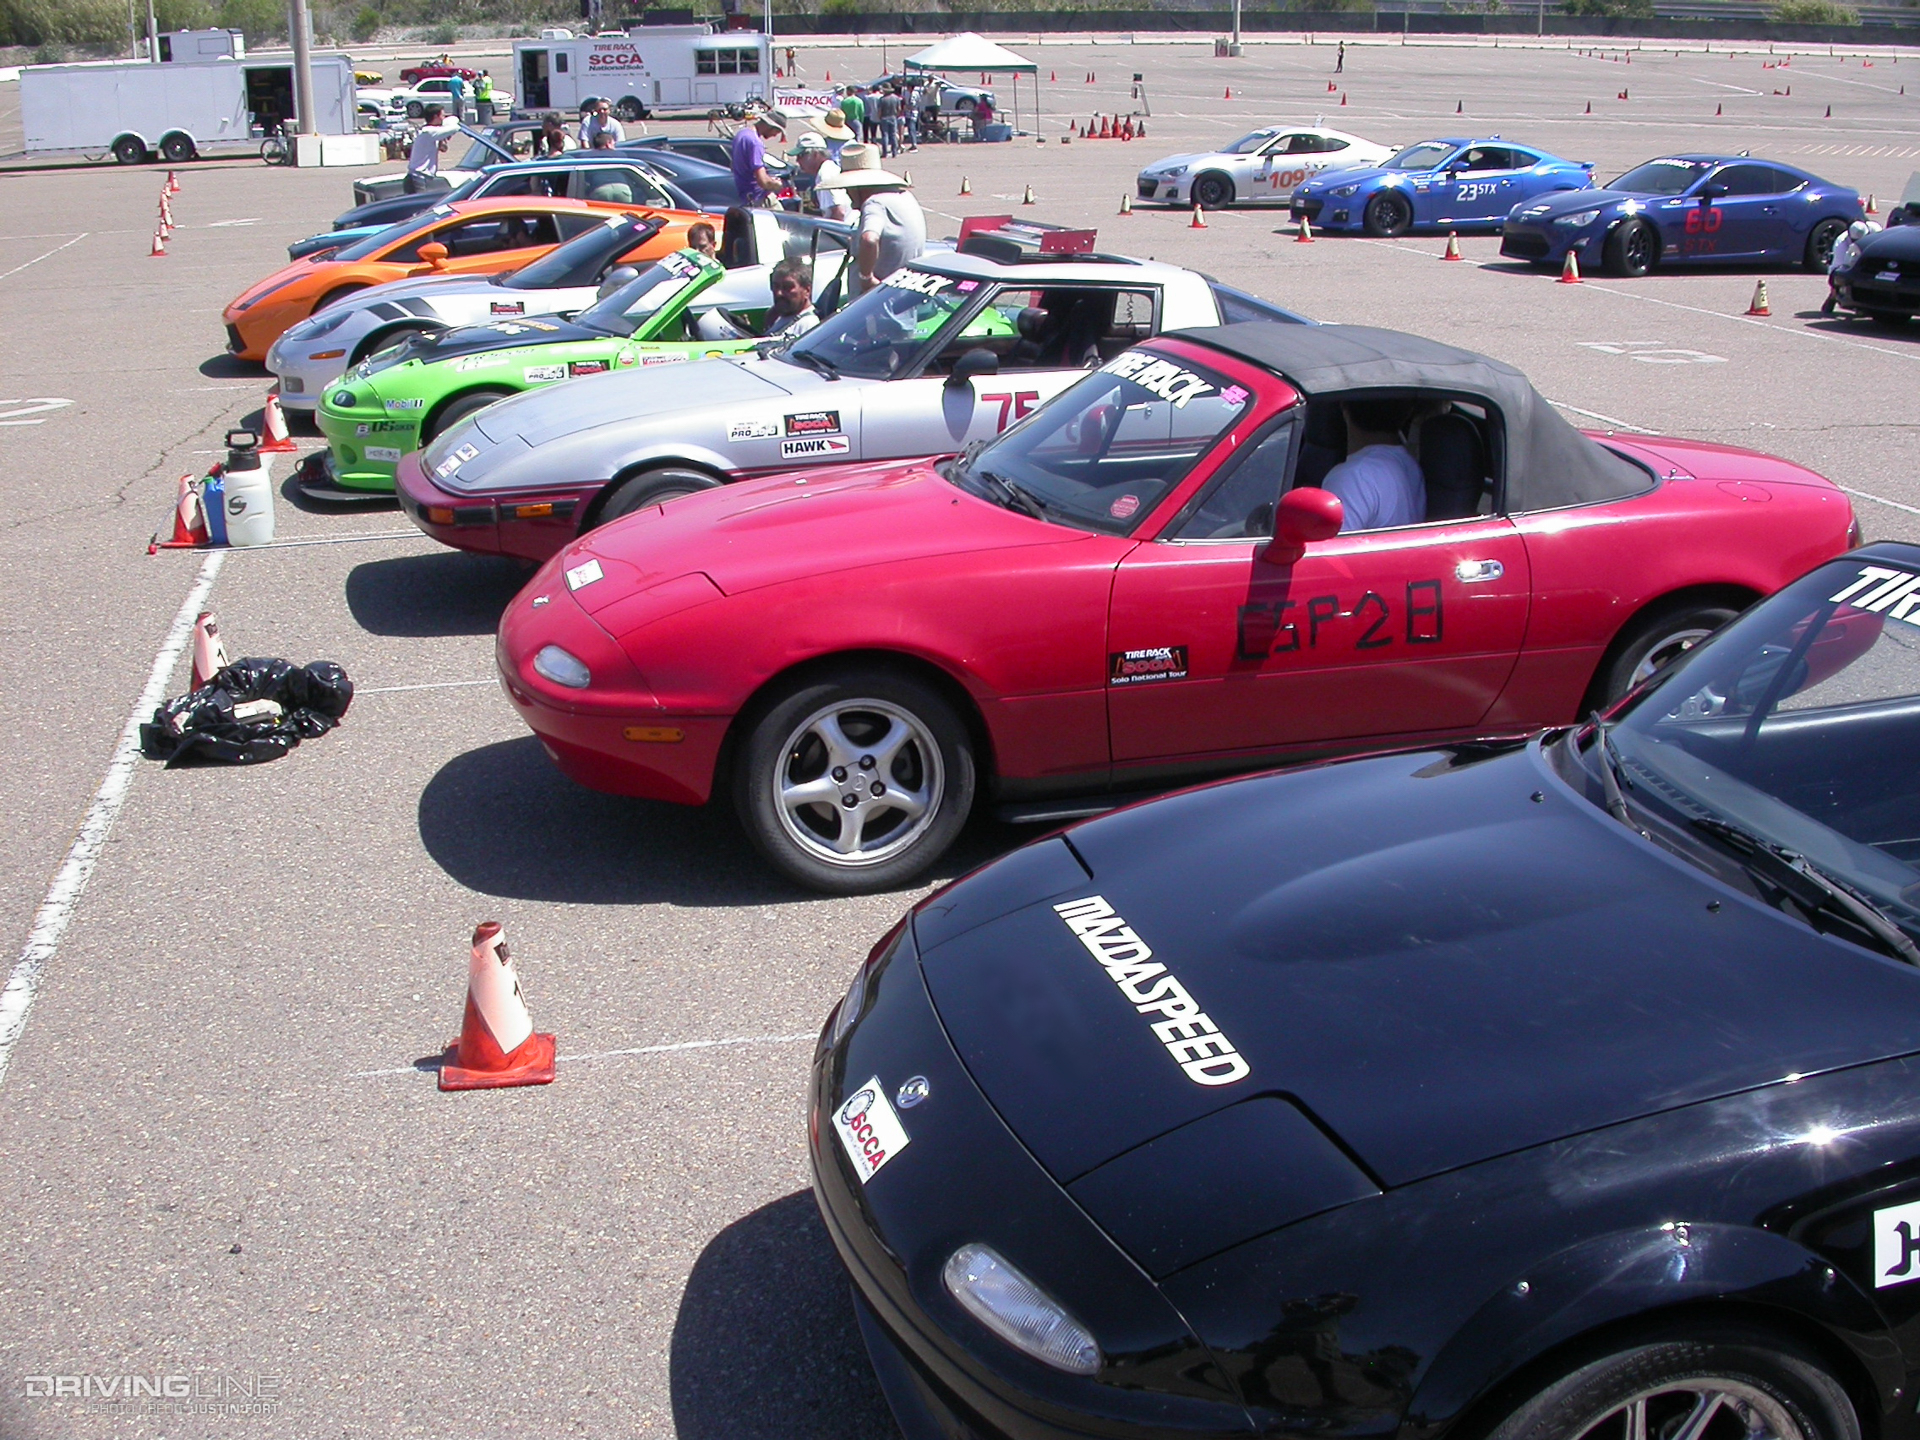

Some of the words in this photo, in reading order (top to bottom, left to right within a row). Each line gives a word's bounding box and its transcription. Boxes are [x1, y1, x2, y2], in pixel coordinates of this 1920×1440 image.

[613, 43, 637, 52] RACK
[589, 54, 643, 65] SCCA
[778, 96, 803, 105] TIRE
[1269, 169, 1305, 189] 109
[1457, 183, 1477, 201] 23
[1129, 360, 1214, 409] RACK
[784, 440, 826, 454] HAWK
[1125, 650, 1145, 659] TIRE
[1146, 647, 1172, 659] RACK
[1052, 895, 1251, 1086] MAZDASPEED
